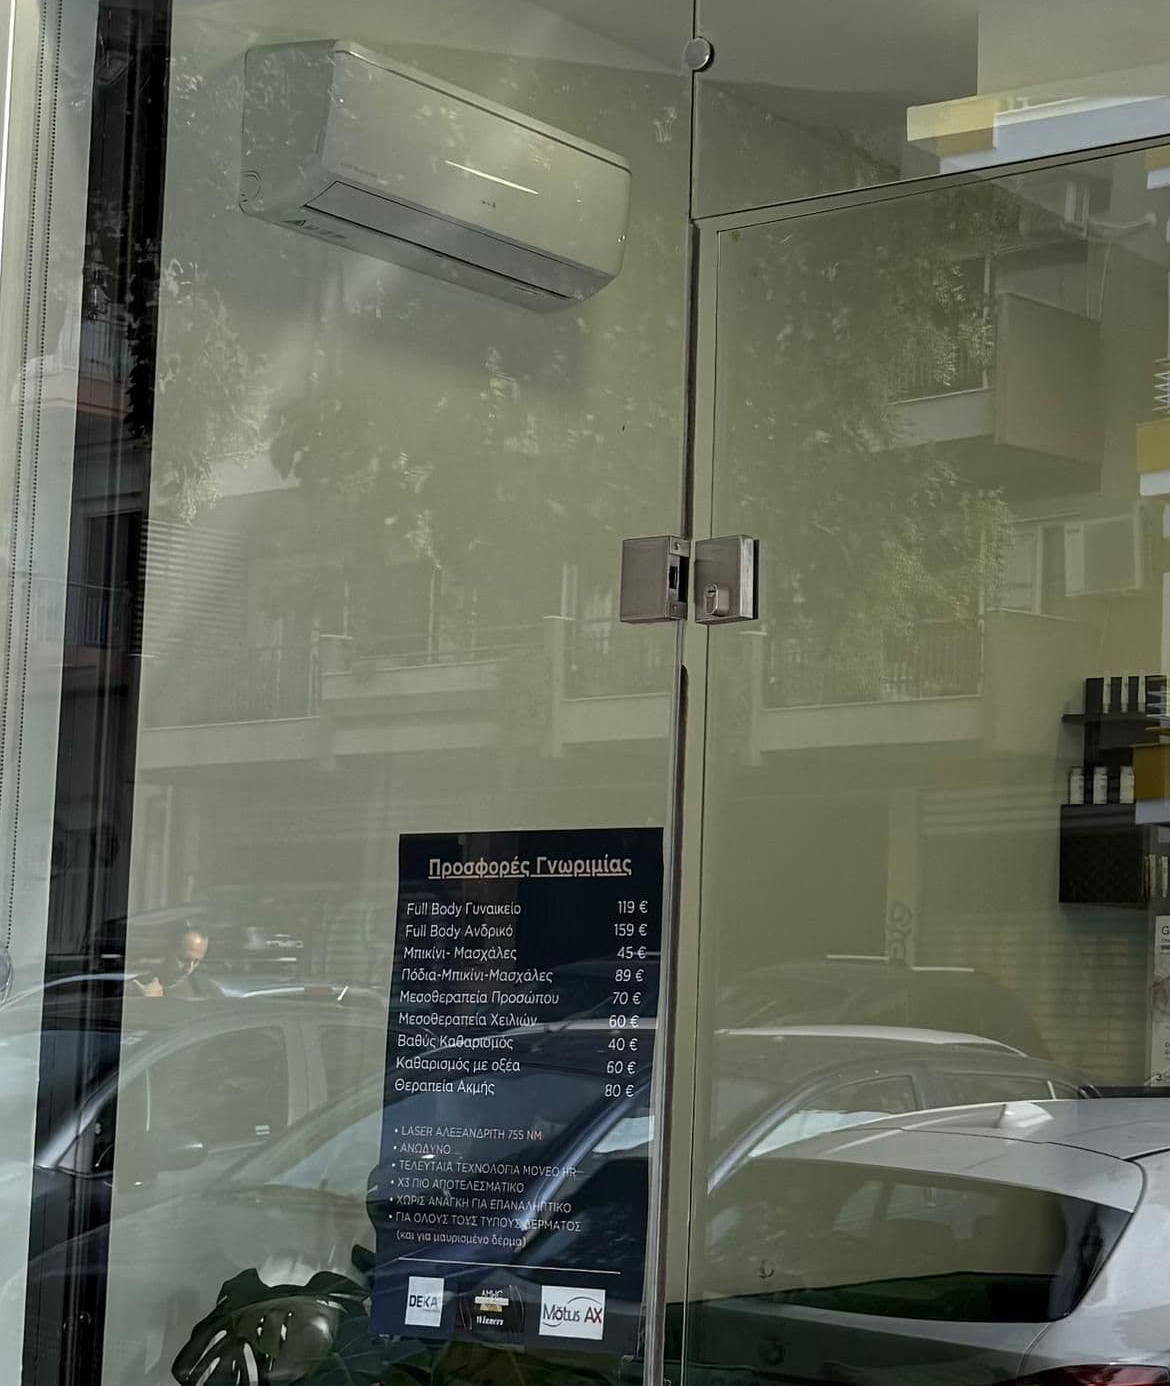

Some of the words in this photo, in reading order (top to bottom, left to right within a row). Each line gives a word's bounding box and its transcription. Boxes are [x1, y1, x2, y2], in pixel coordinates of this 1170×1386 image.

[428, 856, 530, 879] Προσφορές
[535, 855, 632, 877] Γνωριμίας
[407, 903, 428, 914] Full
[432, 903, 462, 917] Body
[465, 901, 521, 917] Γυναικείο
[617, 900, 635, 913] 119
[639, 901, 648, 912] €
[405, 925, 426, 937] Full
[430, 925, 461, 940] Body
[464, 924, 513, 940] Ανδρικό
[614, 923, 634, 936] 159
[639, 924, 647, 936] €
[454, 947, 516, 962] Μασχάλες
[637, 947, 646, 959] €
[615, 969, 631, 981] 89
[635, 969, 644, 982] €
[400, 990, 488, 1006] Μεσοθεραπεία
[492, 990, 559, 1005] Προσώπου
[612, 992, 628, 1004] 70
[633, 992, 641, 1004] €
[399, 1013, 487, 1028] Μεσοθεραπεία
[491, 1013, 537, 1026] Χειλιών
[609, 1015, 625, 1028] 60
[630, 1015, 639, 1028] €
[398, 1035, 436, 1048] Βαθύς
[440, 1036, 513, 1051] Καθαρισμός
[608, 1038, 625, 1050] 40
[629, 1038, 638, 1050] €
[396, 1057, 470, 1073] Καθαρισμός
[474, 1060, 487, 1073] με
[491, 1060, 520, 1074] οξέα
[607, 1061, 623, 1074] 60
[627, 1062, 635, 1074] €
[395, 1079, 453, 1093] Θεραπεία
[457, 1080, 495, 1095] Ακμής
[605, 1084, 621, 1097] 80
[626, 1085, 634, 1097] €
[401, 1126, 432, 1136] LASER
[435, 1127, 504, 1139] ΑΛΕΞΑΝΔΡΙΤΗ
[508, 1131, 524, 1140] 755
[527, 1131, 543, 1140] NM
[400, 1144, 451, 1154] ΑΝΩΔΥΝΟ
[400, 1160, 452, 1172] ΤΕΛΕΥΤΑΙΑ
[457, 1163, 520, 1175] ΤΕΧΝΟΛΟΓΙΑ
[412, 1178, 430, 1189] ΠΙΟ
[432, 1179, 524, 1193] ΑΠΟΤΕΛΕΣΜΑΤΙΚΟ
[397, 1194, 425, 1205] ΧΩΡΙΣ
[429, 1196, 469, 1207] ΑΝΑΓΚΗ
[472, 1198, 487, 1208] ΓΙΑ
[396, 1212, 410, 1222] ΓΙΑ
[413, 1213, 448, 1224] ΟΛΟΥΣ
[451, 1214, 478, 1226] ΤΟΥΣ
[481, 1217, 521, 1228] ΤΥΠΟΥΣ
[417, 1232, 431, 1242] για
[434, 1232, 488, 1247] μαυρισμένο
[409, 1295, 438, 1308] DEKA
[584, 1306, 602, 1323] AX
